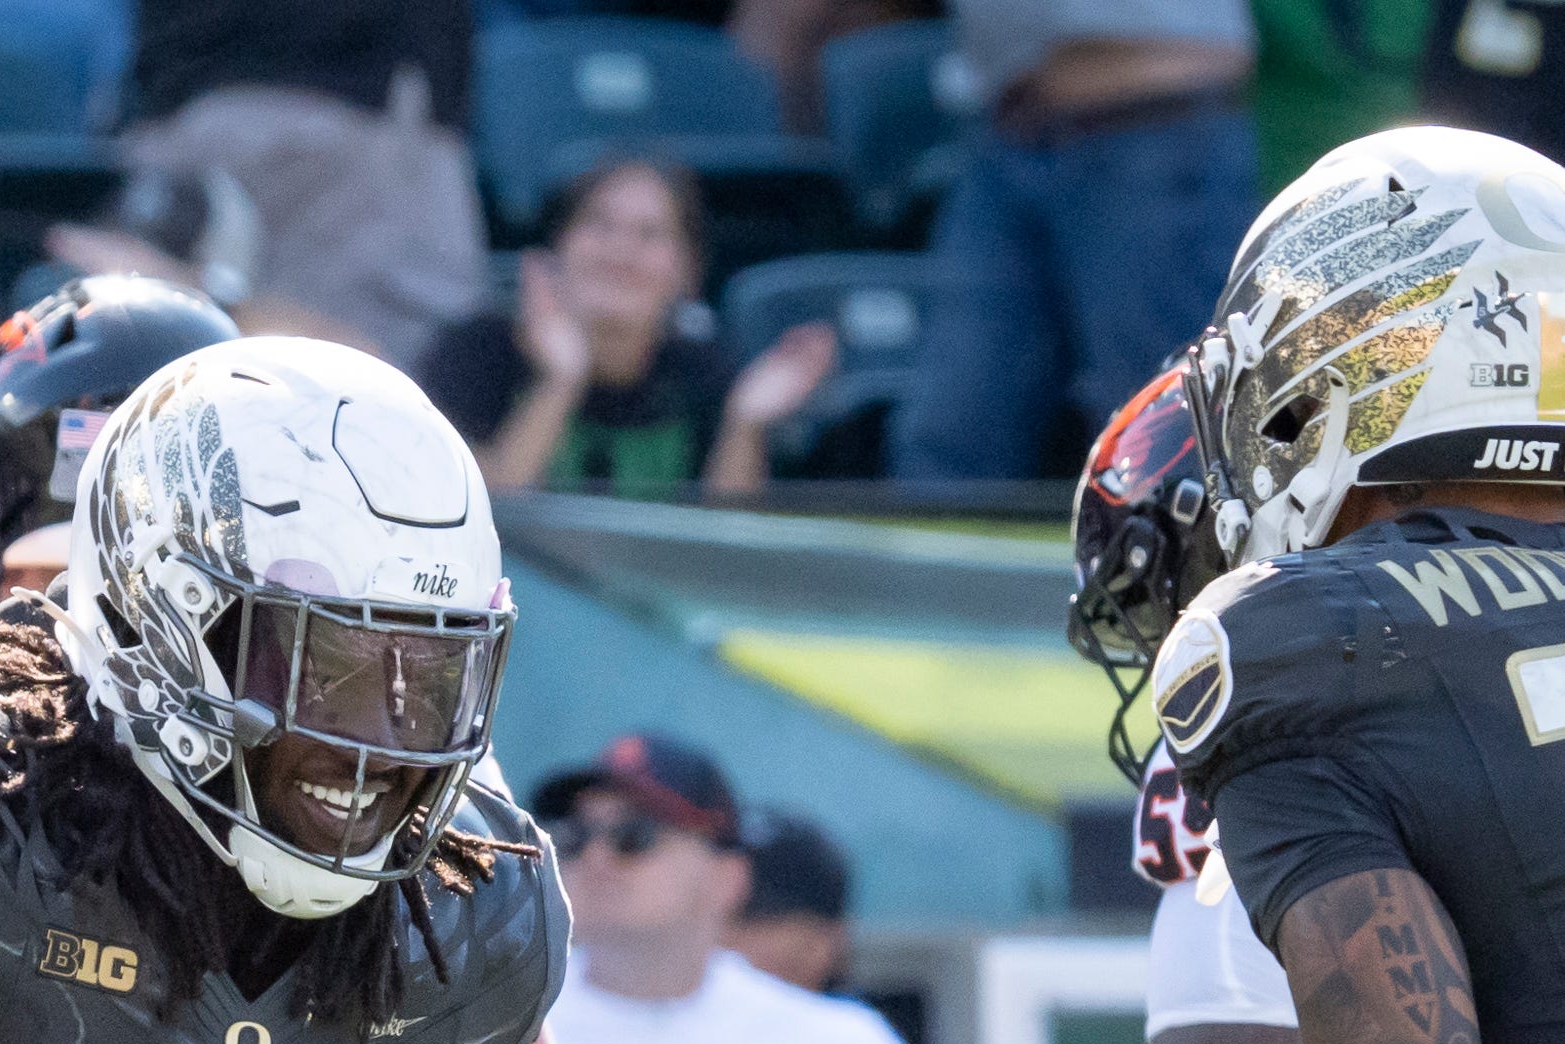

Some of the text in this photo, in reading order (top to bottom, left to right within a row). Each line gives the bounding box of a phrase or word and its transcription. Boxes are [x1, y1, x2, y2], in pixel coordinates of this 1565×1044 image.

[1474, 438, 1560, 472] JUST
[413, 564, 458, 598] nike
[1375, 546, 1565, 627] WOO
